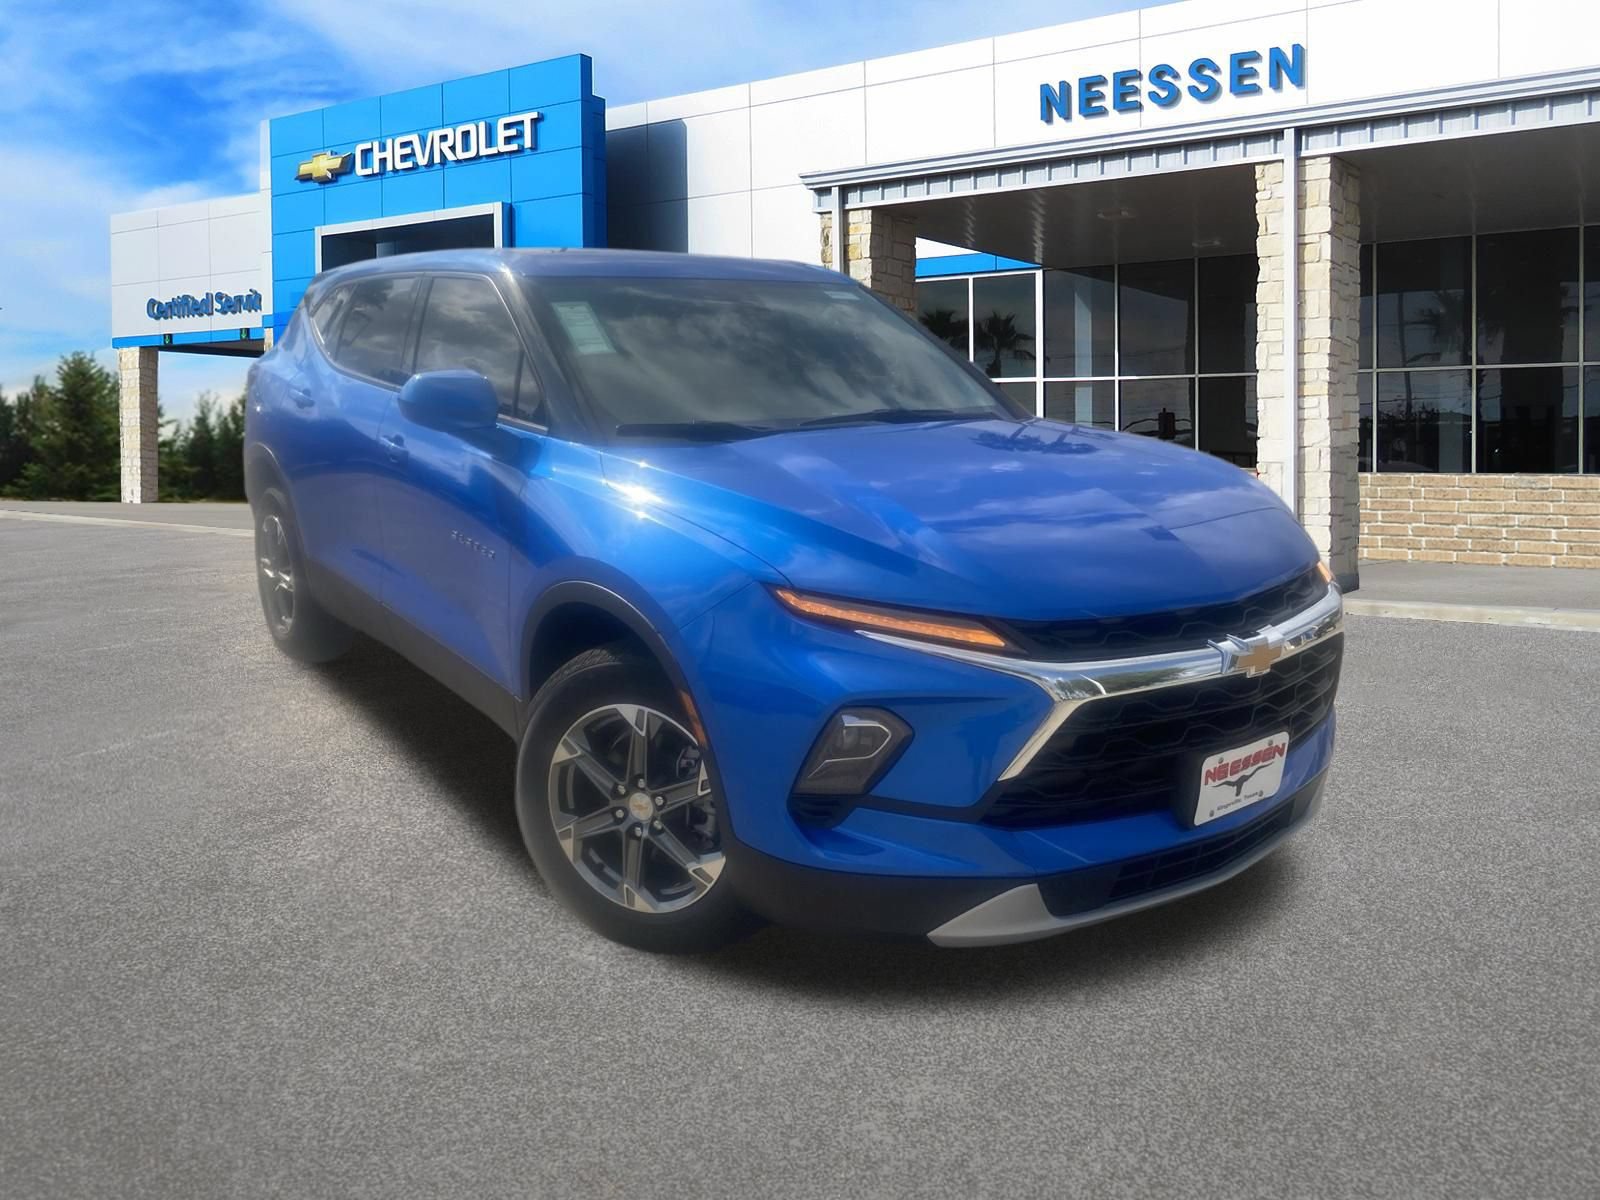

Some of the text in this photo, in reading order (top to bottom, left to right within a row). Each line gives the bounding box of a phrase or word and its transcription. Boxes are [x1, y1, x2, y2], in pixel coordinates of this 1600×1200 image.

[1040, 43, 1305, 124] NEESSEN
[354, 111, 542, 177] CHEVROLET
[147, 293, 213, 320] Certified
[1204, 743, 1286, 786] NEESSEN
